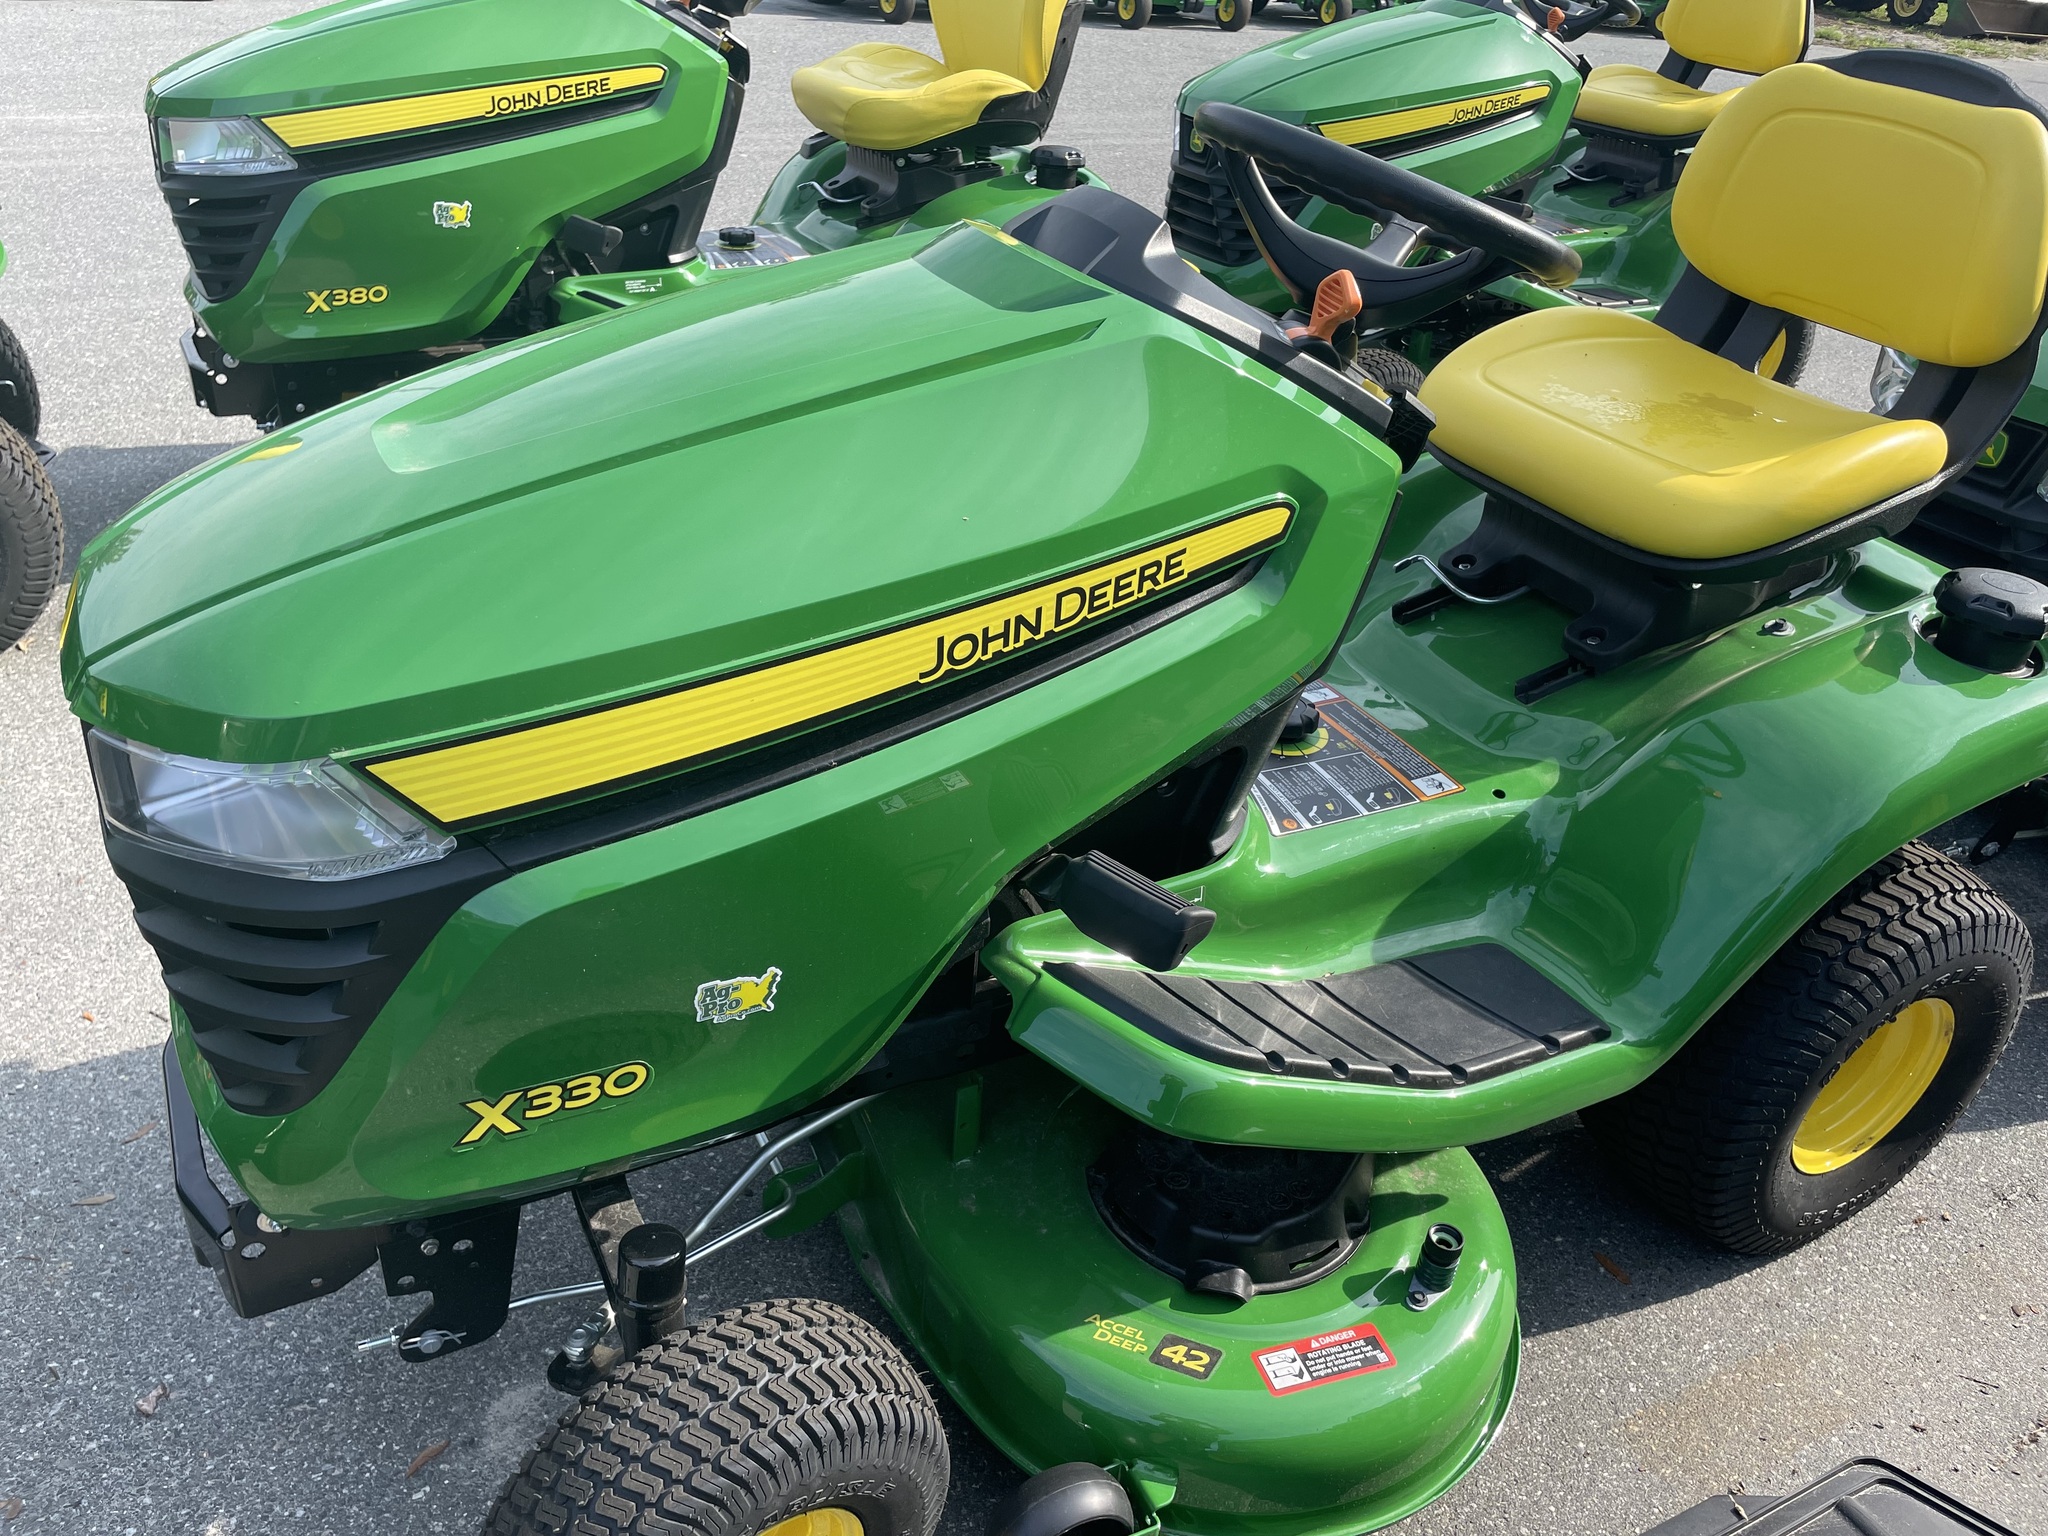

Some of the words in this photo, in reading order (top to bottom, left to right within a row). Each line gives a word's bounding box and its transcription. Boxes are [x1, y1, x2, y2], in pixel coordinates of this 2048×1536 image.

[484, 90, 541, 115] JOHN
[546, 77, 611, 102] DEERE
[1448, 104, 1483, 123] JOHN
[1484, 94, 1521, 114] DEERE
[304, 284, 389, 314] X380
[917, 605, 1043, 682] JOHN
[1053, 546, 1188, 631] DEERE
[700, 985, 741, 1006] Ag-
[701, 998, 742, 1019] Pro
[452, 1061, 650, 1147] X330
[1084, 1314, 1146, 1341] ACCEL
[1319, 1330, 1356, 1345] DANGER
[1093, 1328, 1148, 1353] DEEP
[1307, 1345, 1342, 1359] ROTATING
[1342, 1339, 1366, 1351] BLADE
[1161, 1345, 1211, 1373] 42
[1306, 1359, 1315, 1367] Do
[1316, 1357, 1326, 1365] not
[1326, 1355, 1336, 1364] put
[1336, 1349, 1354, 1360] hands
[1309, 1363, 1326, 1372] under
[1346, 1354, 1365, 1363] mower
[1366, 1349, 1381, 1358] when
[1312, 1369, 1333, 1378] engine
[1339, 1361, 1362, 1372] running
